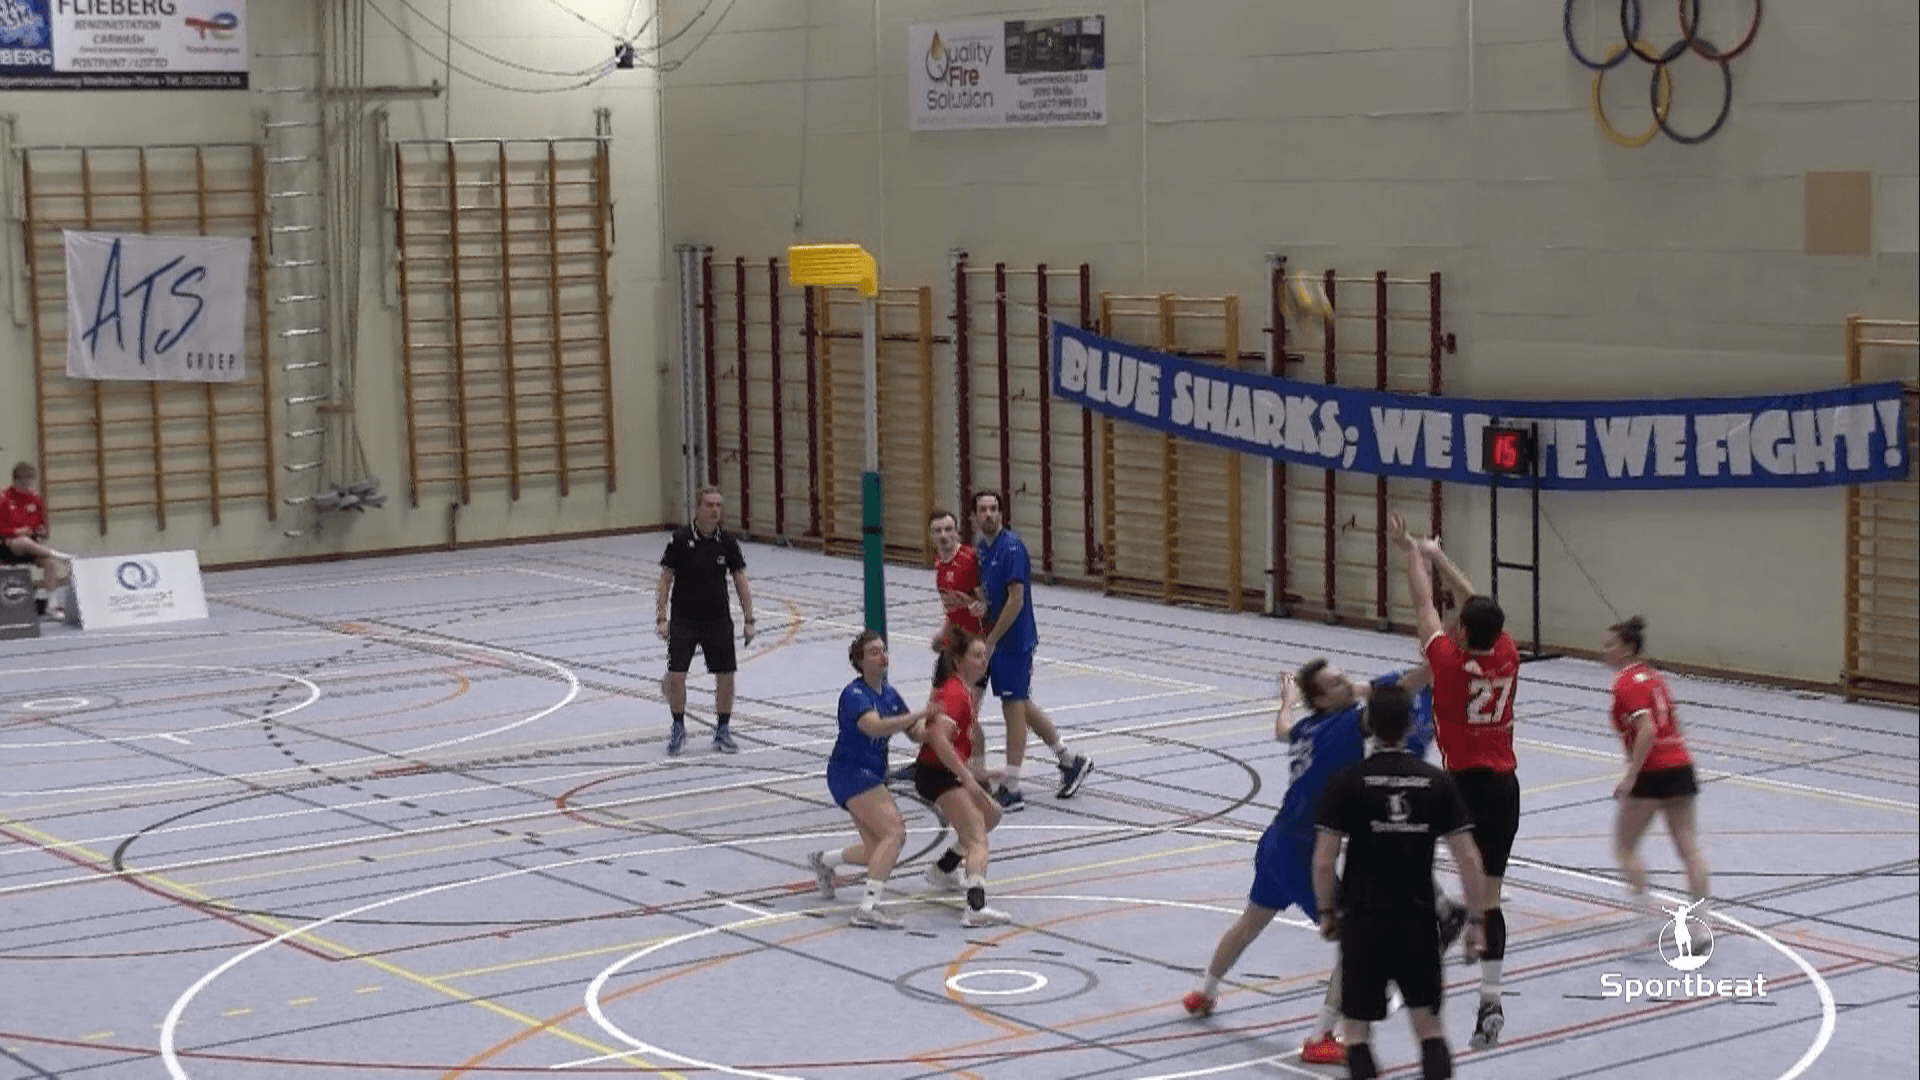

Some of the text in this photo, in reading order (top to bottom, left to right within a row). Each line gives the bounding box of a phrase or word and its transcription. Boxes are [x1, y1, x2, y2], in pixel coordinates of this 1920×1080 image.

[58, 0, 176, 15] FLIEBERG
[950, 66, 980, 86] Fire
[926, 89, 994, 110] Solution
[82, 238, 205, 365] ATS
[186, 352, 236, 370] GROEP
[1060, 336, 1162, 417] BLUE
[1171, 371, 1360, 469] SHARKS;
[1370, 406, 1453, 469] WE
[1594, 414, 1687, 478] WE
[1694, 399, 1902, 475] FIGHT!
[1492, 432, 1518, 469] 15
[1466, 677, 1514, 724] 27
